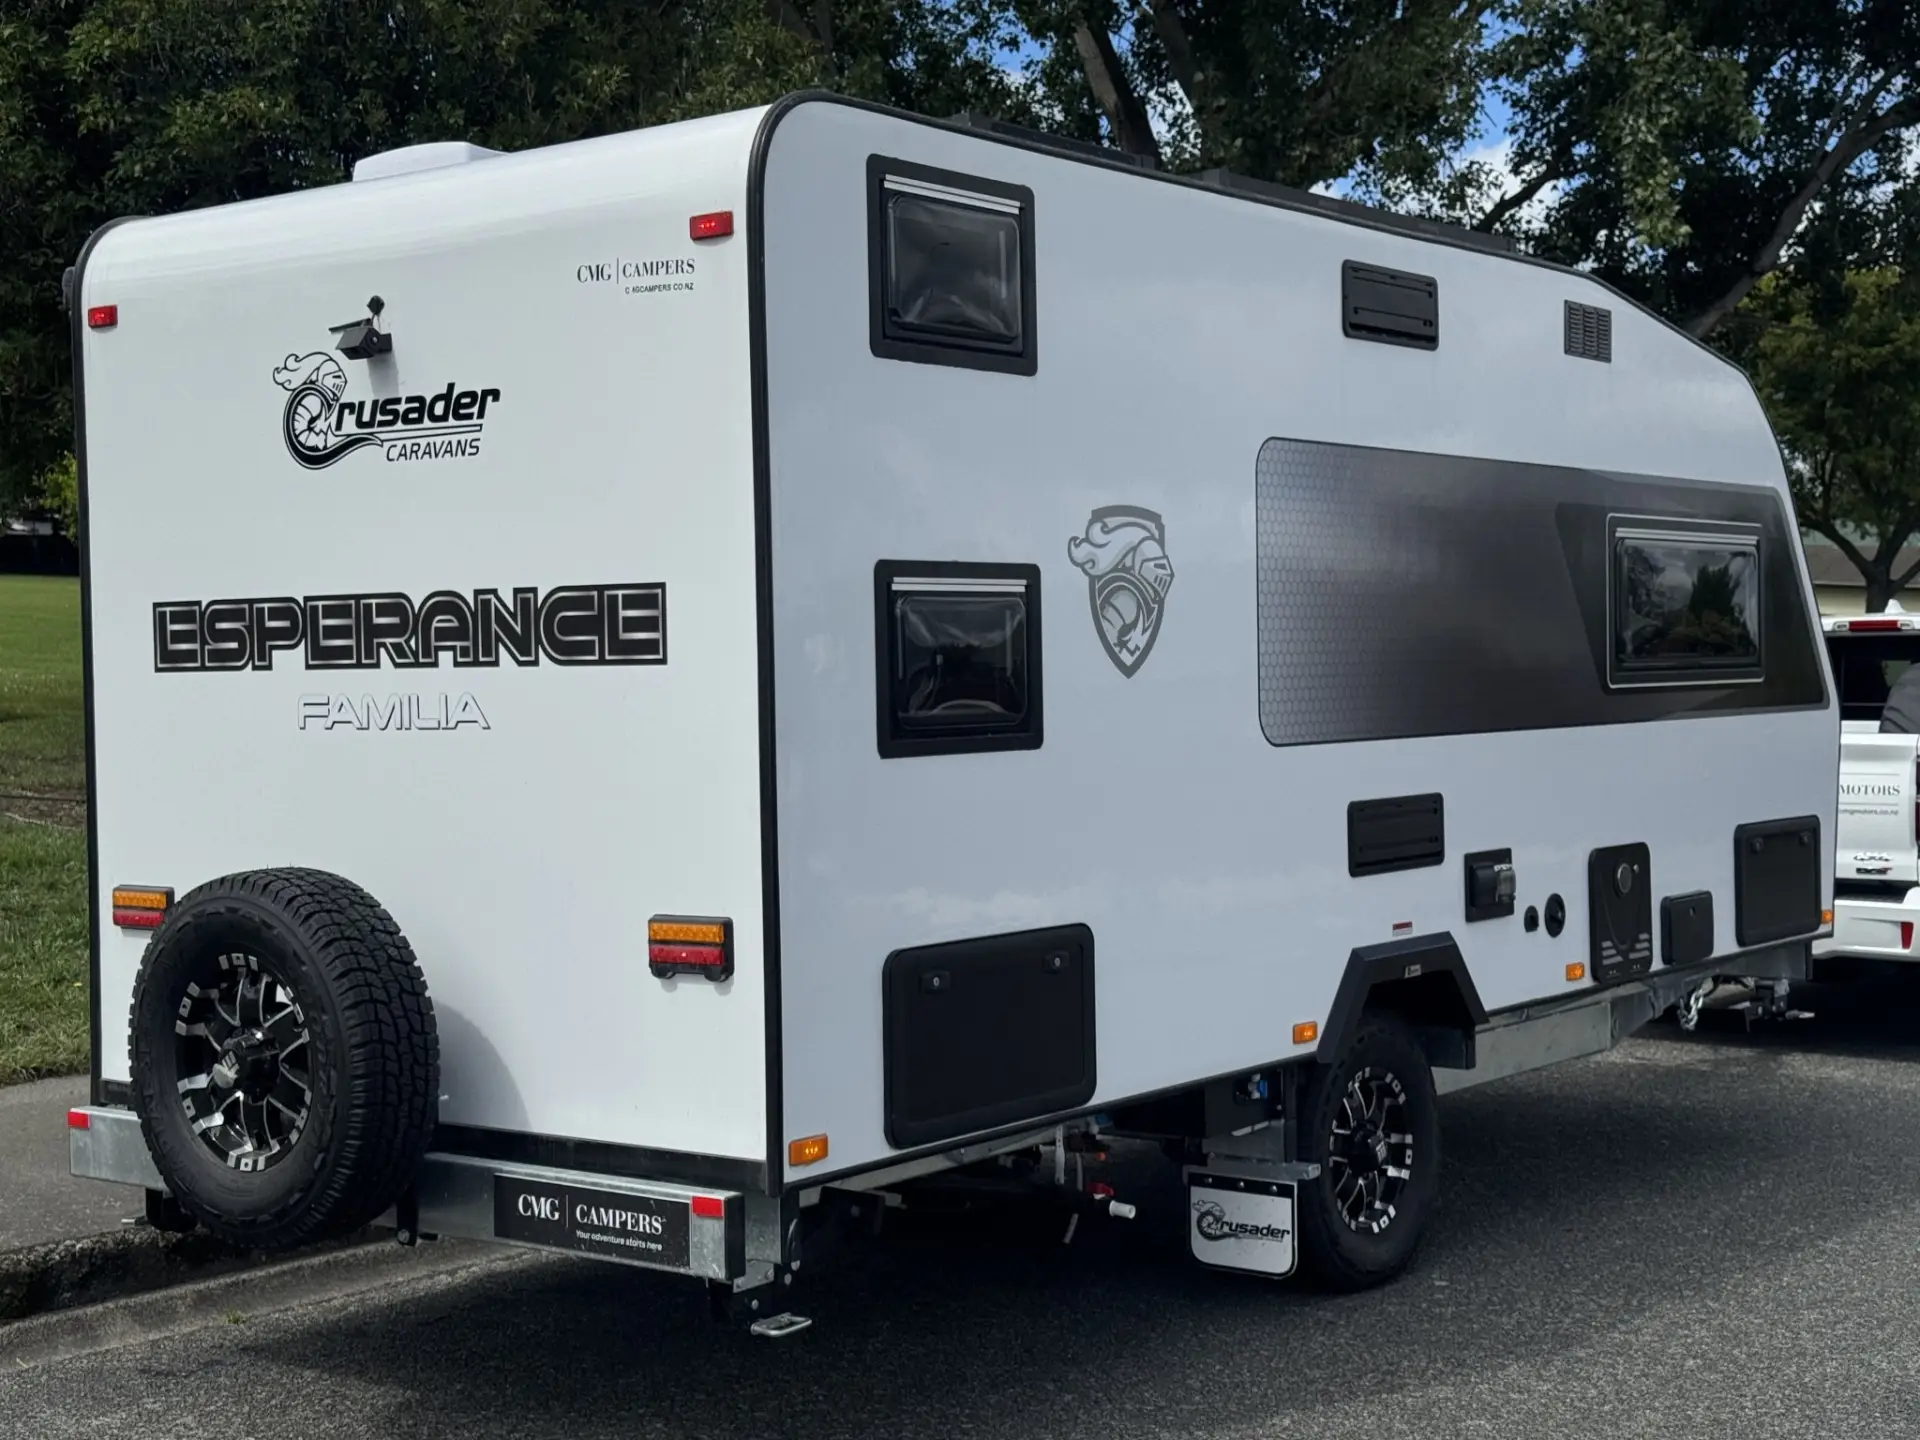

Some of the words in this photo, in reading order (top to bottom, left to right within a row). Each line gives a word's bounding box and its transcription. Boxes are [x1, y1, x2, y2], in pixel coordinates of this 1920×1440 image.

[576, 263, 612, 284] CMG
[622, 258, 696, 278] CAMPERS
[386, 438, 481, 462] CARAVANS
[152, 582, 668, 673] ESPERANCE
[297, 692, 491, 730] FAMILIA
[1839, 784, 1900, 796] MOTORS
[517, 1193, 560, 1221] CMG
[575, 1204, 663, 1235] CAMPERS
[575, 1229, 590, 1240] Your
[591, 1232, 625, 1245] adventure
[625, 1237, 646, 1249] starts
[646, 1241, 663, 1252] here
